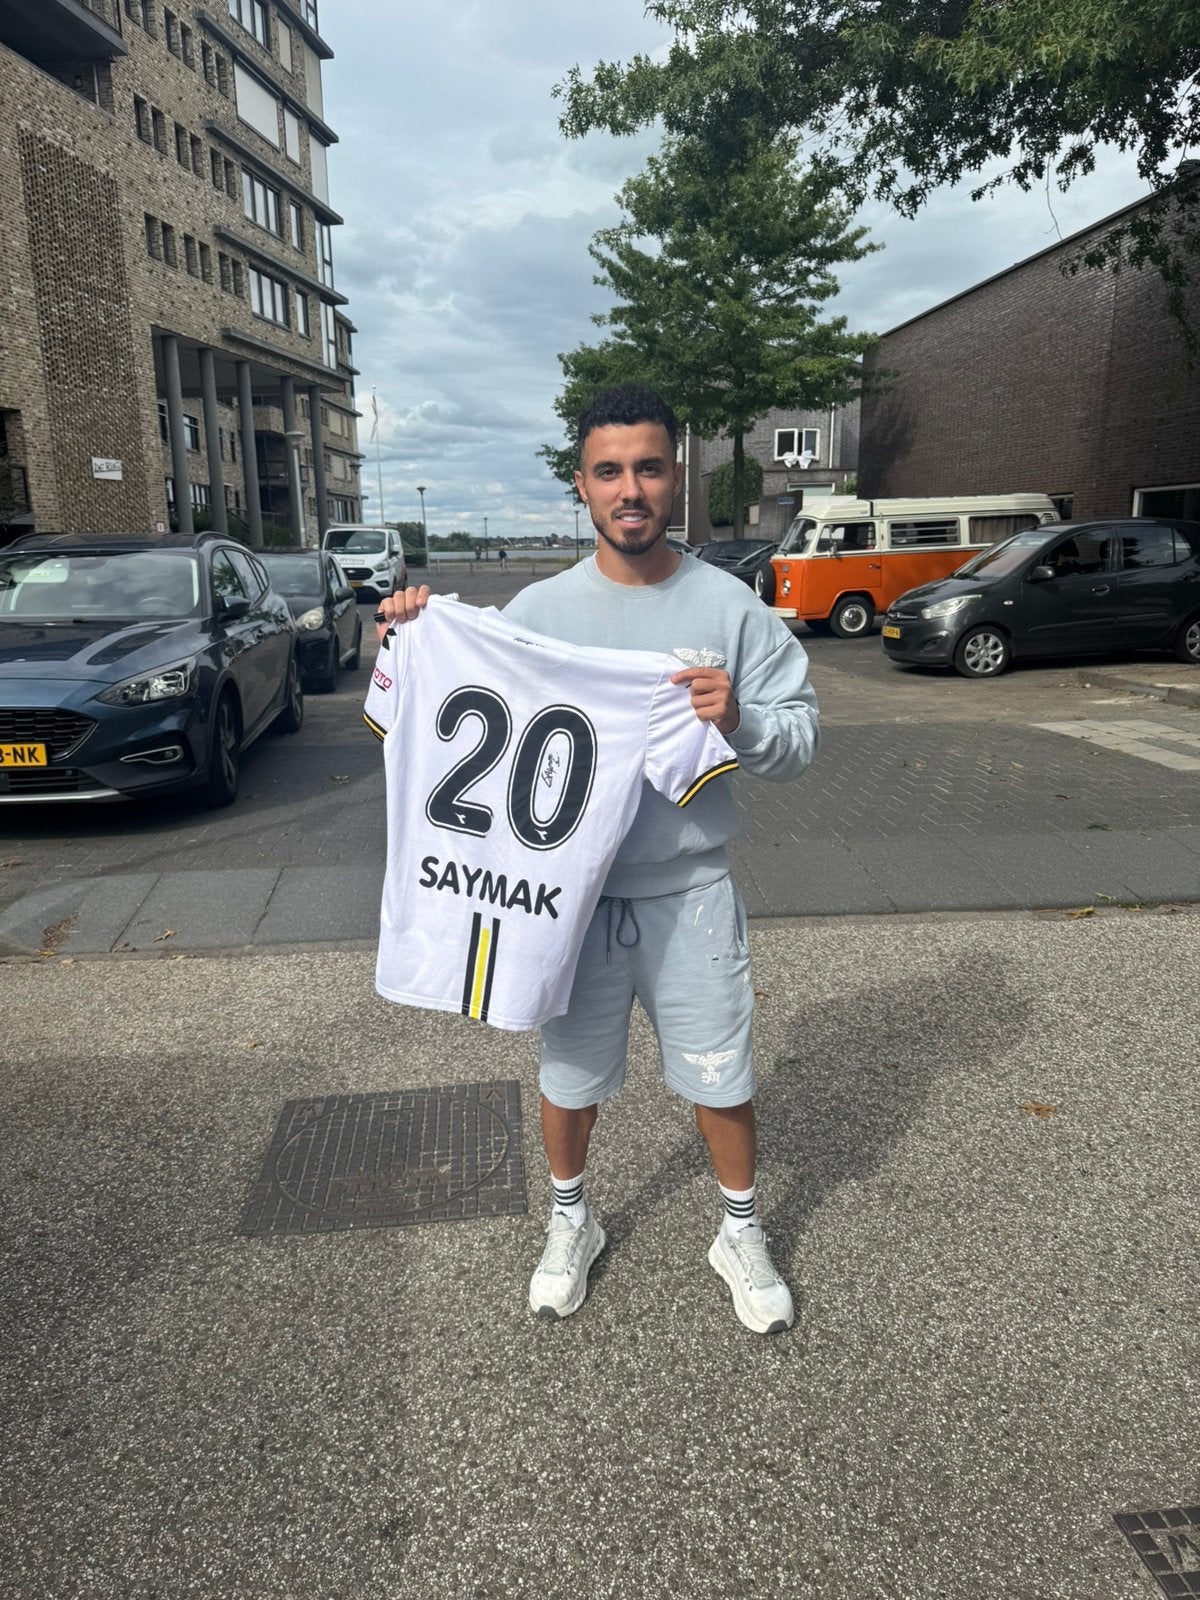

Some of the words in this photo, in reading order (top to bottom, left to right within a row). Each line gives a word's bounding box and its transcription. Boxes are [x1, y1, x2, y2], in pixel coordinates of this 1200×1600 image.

[373, 667, 393, 689] OTO
[426, 685, 598, 851] 20
[419, 855, 562, 919] SAYMAK
